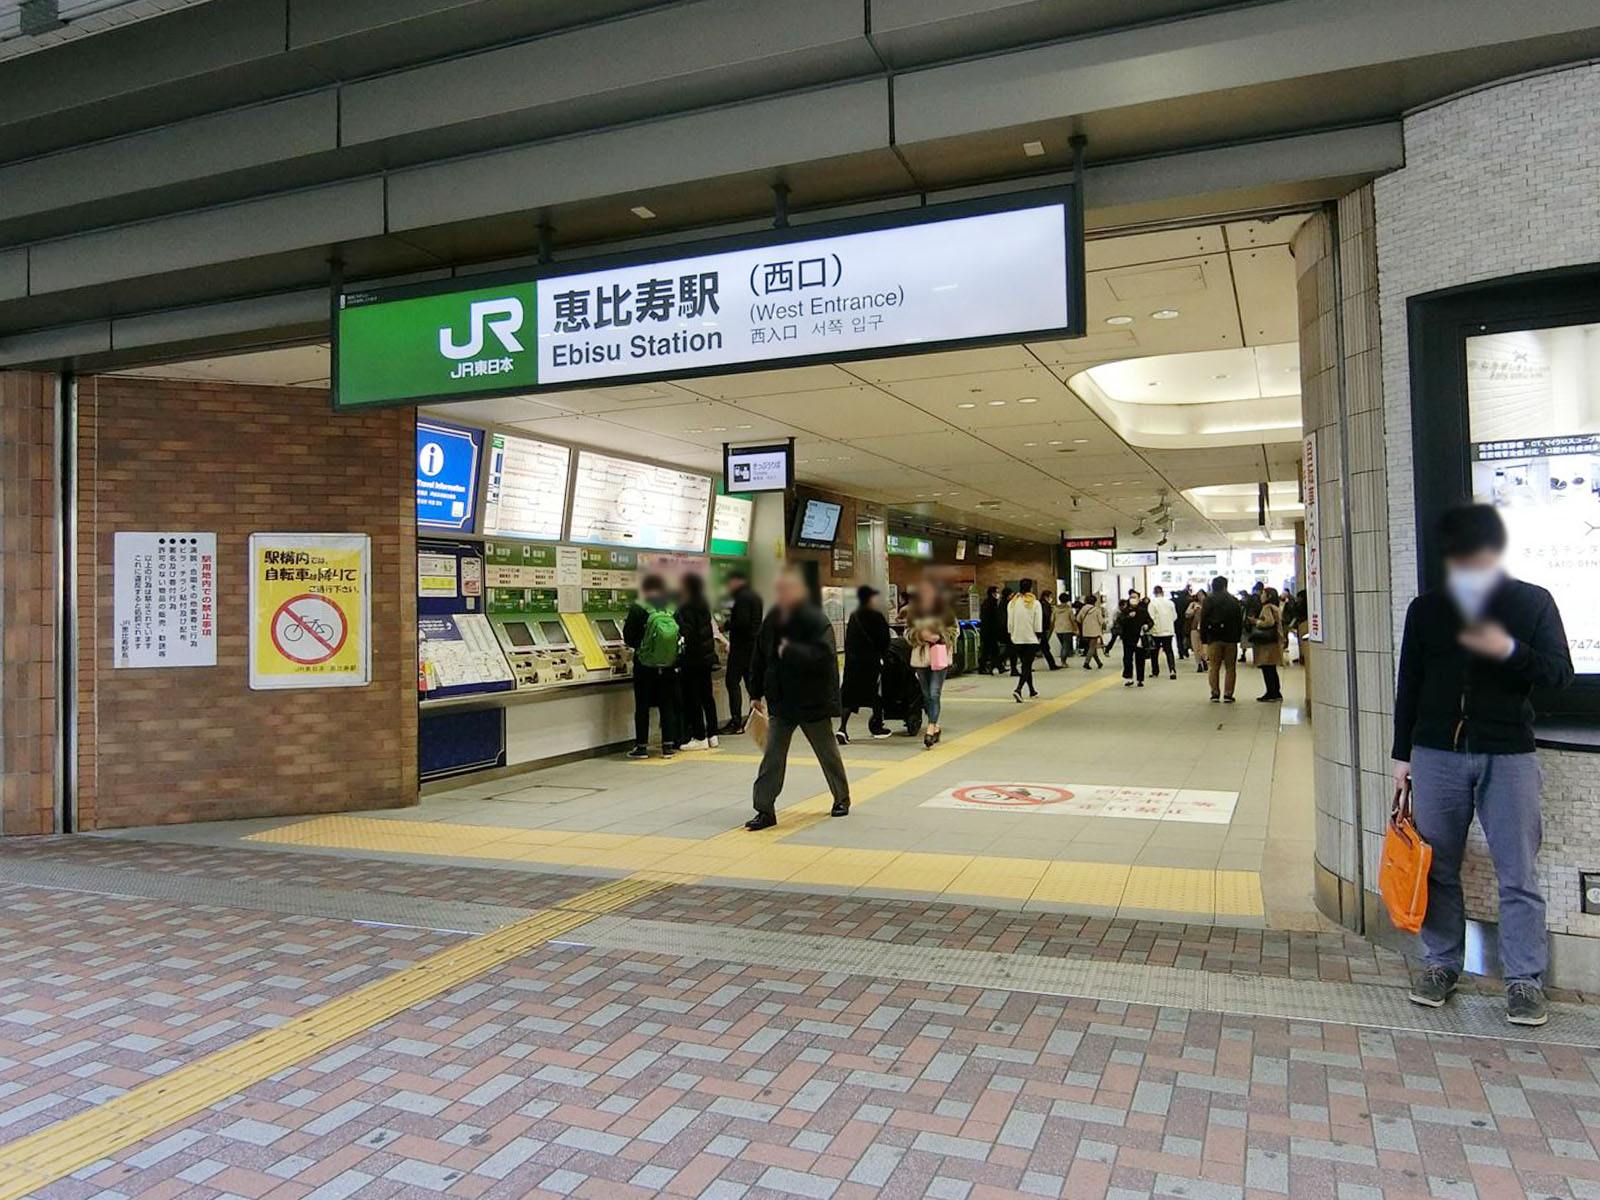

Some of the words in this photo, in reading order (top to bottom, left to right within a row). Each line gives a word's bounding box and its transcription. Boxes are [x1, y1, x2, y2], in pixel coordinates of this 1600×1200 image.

[750, 253, 842, 297] (西口)
[553, 271, 720, 334] 恵比寿駅
[750, 303, 803, 324] (West
[811, 285, 904, 316] Entrance)
[439, 297, 525, 360] JR
[751, 324, 797, 345] 西入口
[812, 319, 843, 337] 서쪽
[852, 314, 884, 333] 입구
[450, 356, 513, 379] JR東日本
[553, 341, 621, 368] Ebisu
[630, 330, 722, 359] Station
